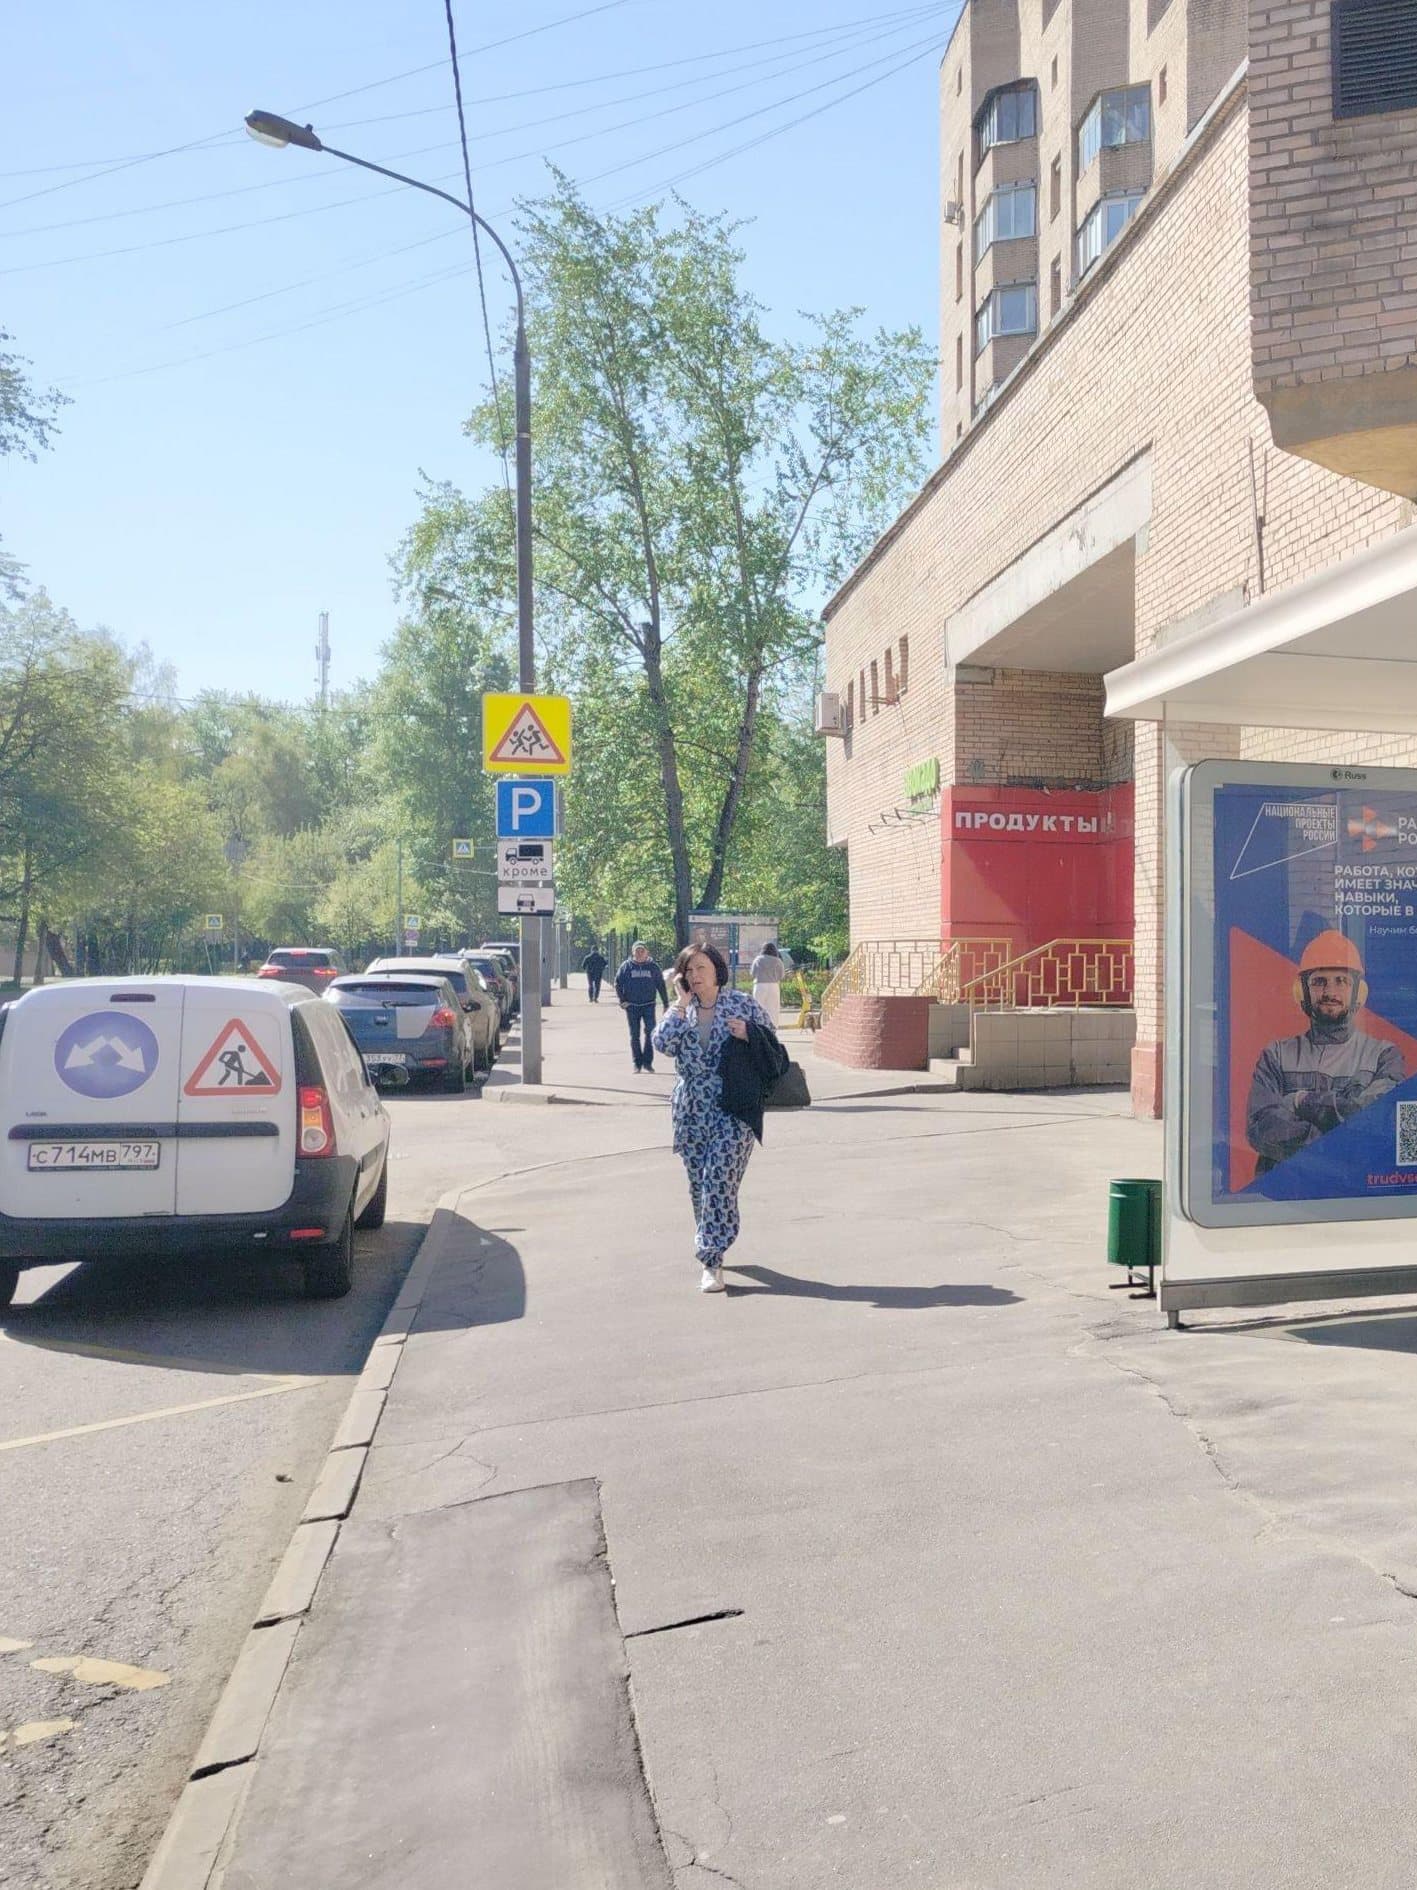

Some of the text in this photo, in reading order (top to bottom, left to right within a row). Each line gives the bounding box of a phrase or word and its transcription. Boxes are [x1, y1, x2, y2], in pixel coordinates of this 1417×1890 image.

[1345, 771, 1367, 781] Russ
[512, 788, 542, 830] P
[1265, 805, 1335, 818] НАЦИОНАЛЬНЫЕ
[955, 812, 1097, 833] ПРОДУКТЫ
[1295, 818, 1336, 829] ПРОЕКТЫ
[1303, 829, 1336, 841] РОССИИ
[503, 867, 548, 879] кроме
[1335, 865, 1393, 878] РАБОТА,
[1335, 879, 1383, 889] ИМЕЕТ
[1335, 892, 1398, 904] НАВЫКИ,
[1335, 905, 1402, 916] КОТОРЫЕ
[1405, 906, 1413, 917] В
[1370, 926, 1406, 936] Научим
